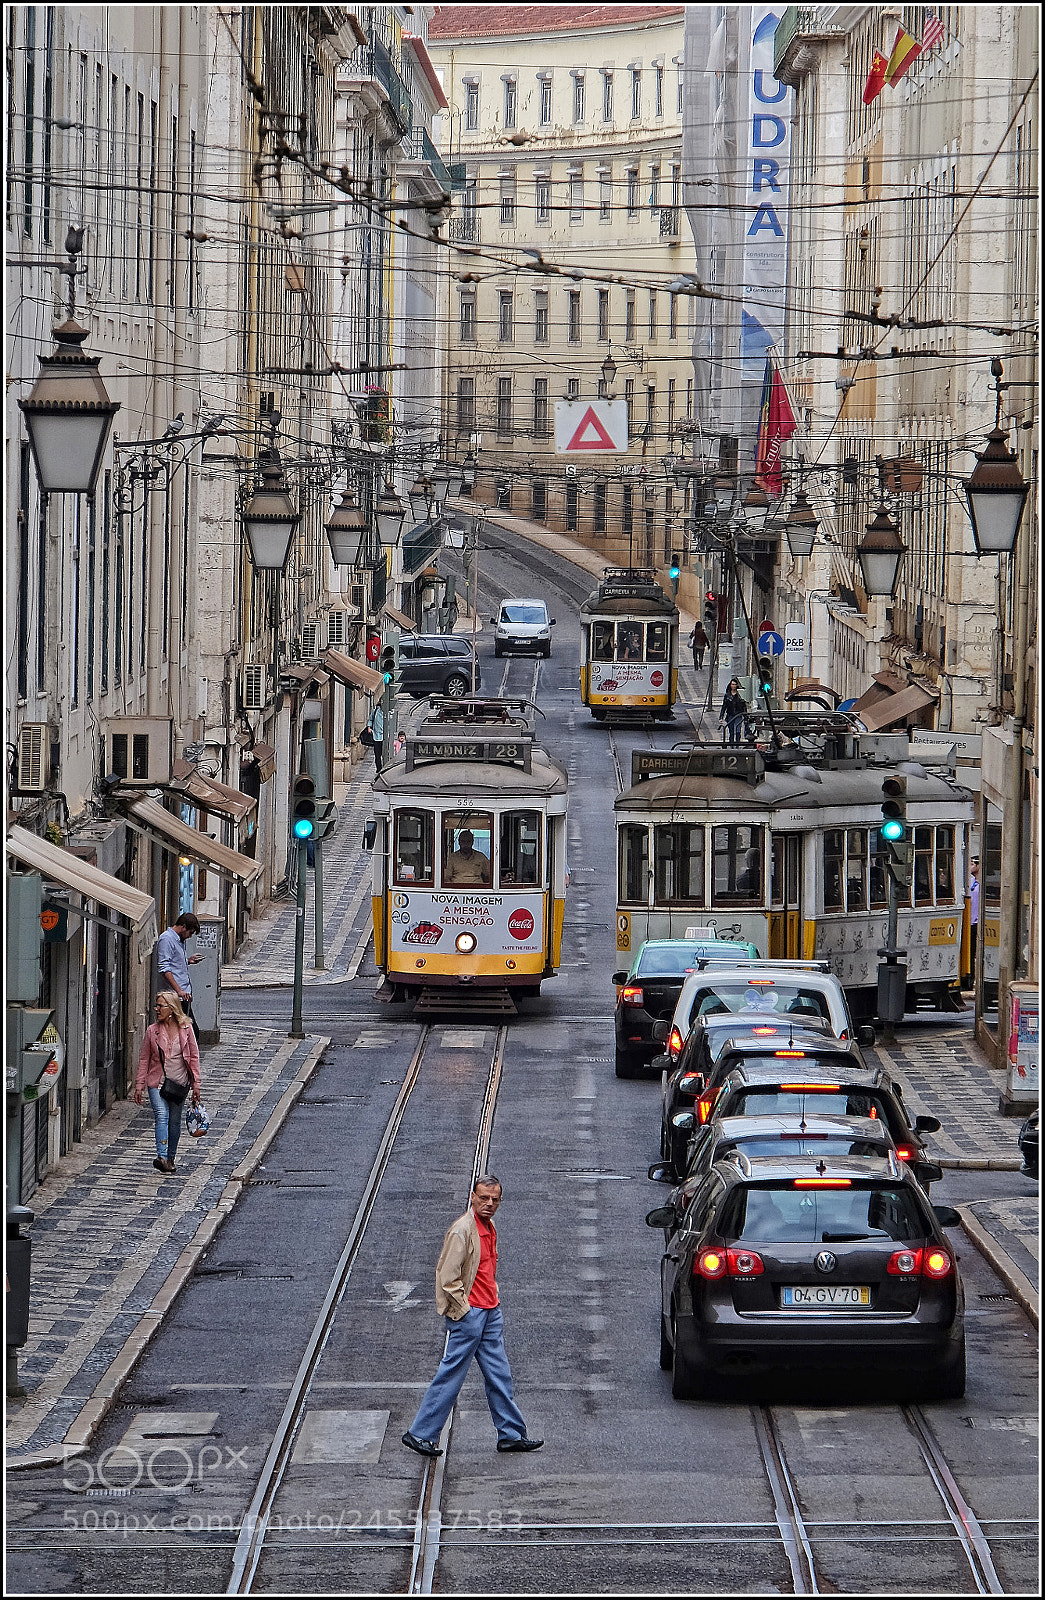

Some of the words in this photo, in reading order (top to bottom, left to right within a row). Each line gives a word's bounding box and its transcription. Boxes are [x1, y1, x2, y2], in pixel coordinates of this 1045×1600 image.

[786, 638, 804, 647] P&B
[495, 744, 517, 757] 28
[720, 756, 738, 770] 12
[431, 894, 460, 904] NOVA
[462, 896, 503, 905] IMAGEM
[443, 906, 450, 914] A
[453, 906, 490, 916] MESMA
[439, 915, 495, 927] SENSAÇÃO
